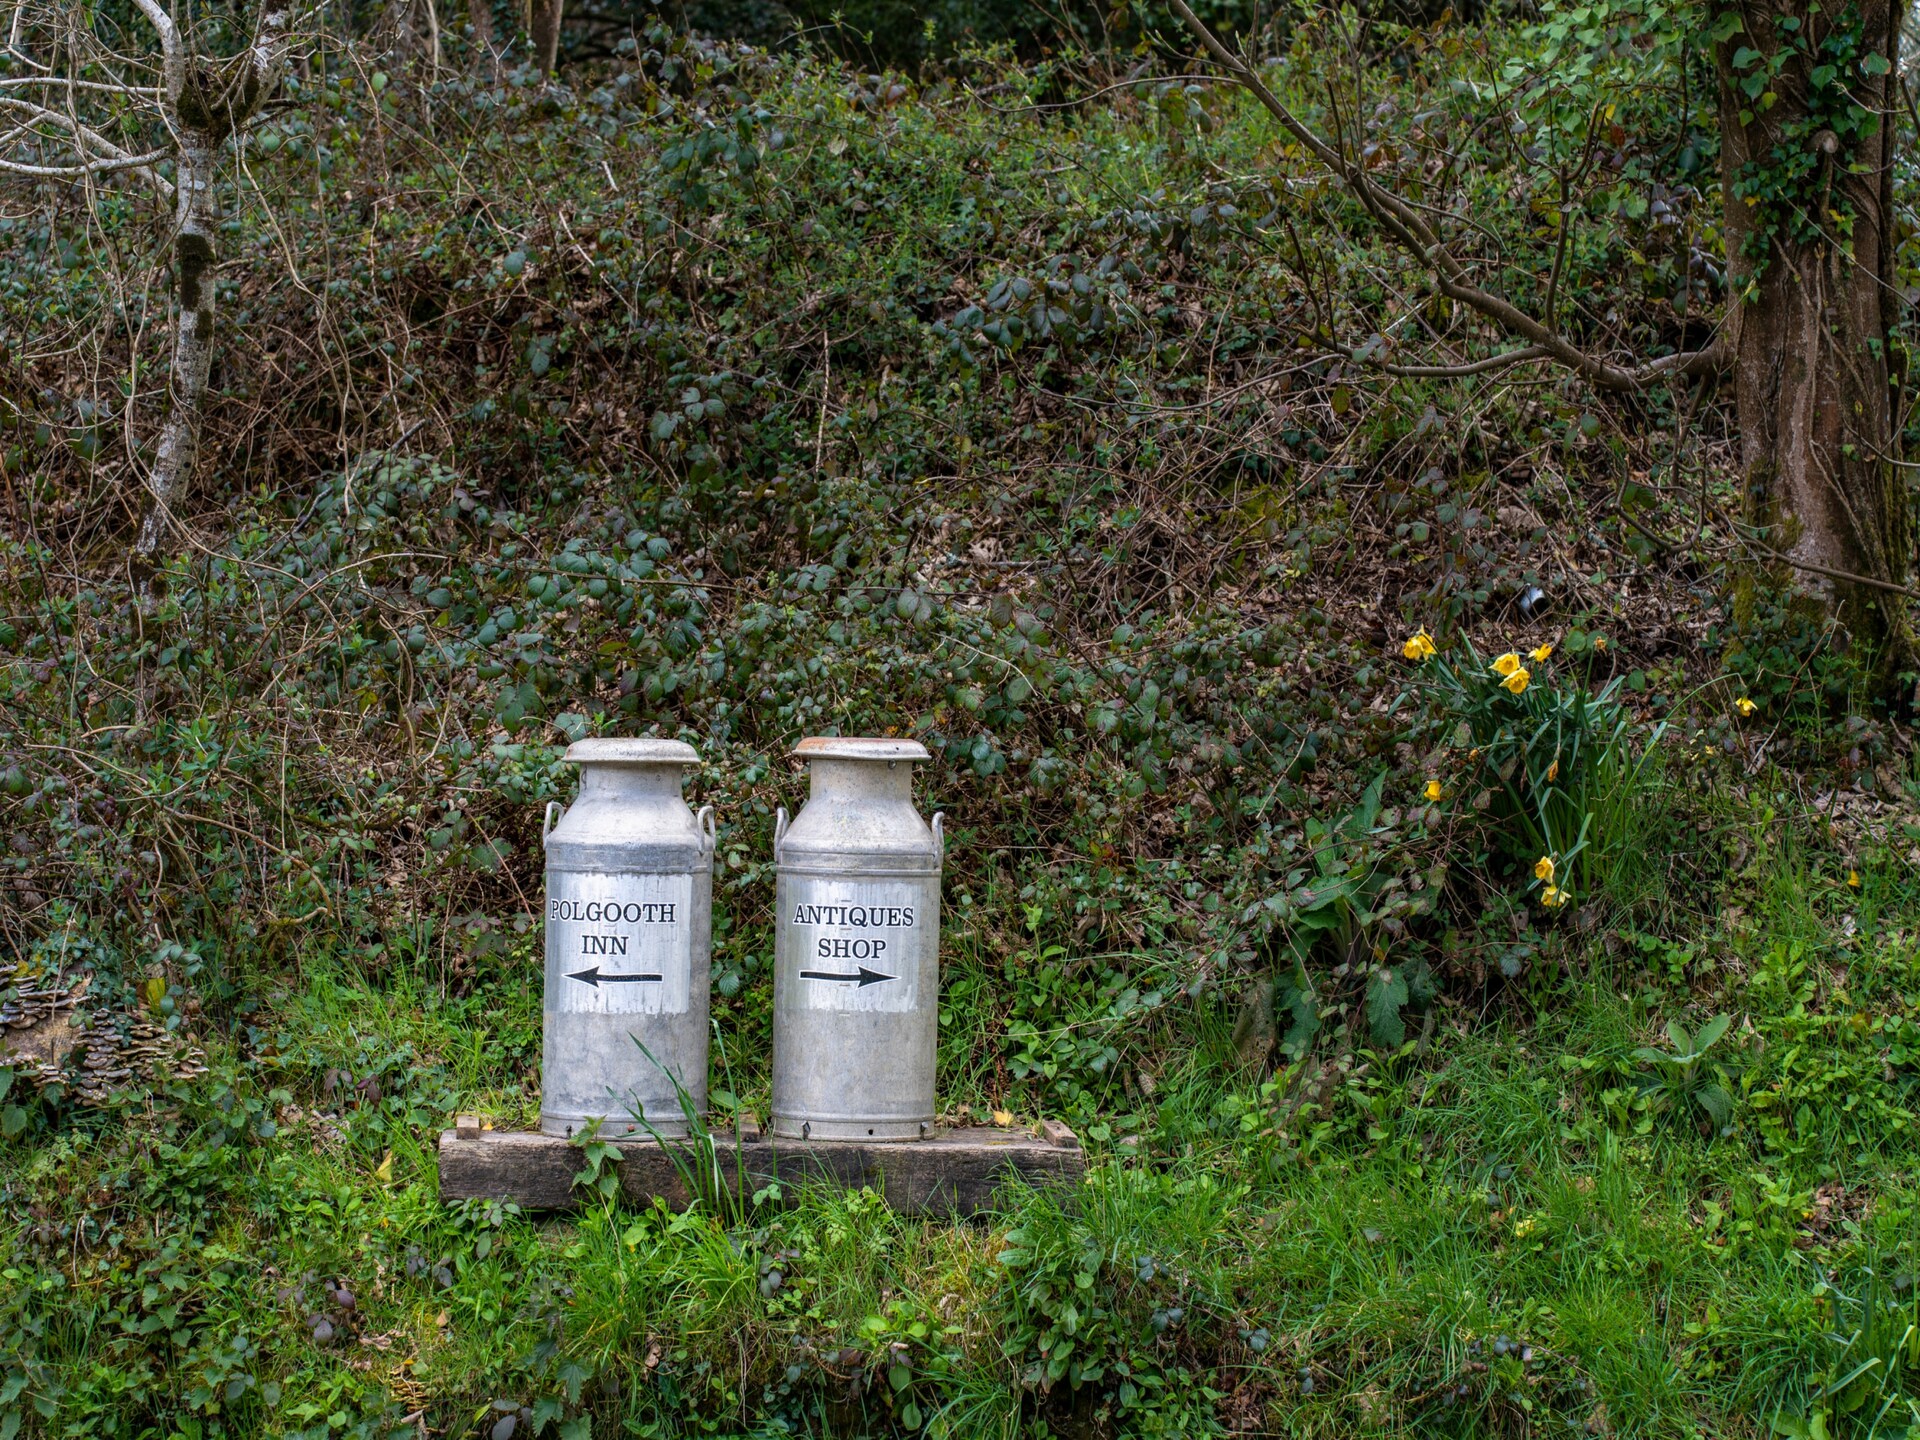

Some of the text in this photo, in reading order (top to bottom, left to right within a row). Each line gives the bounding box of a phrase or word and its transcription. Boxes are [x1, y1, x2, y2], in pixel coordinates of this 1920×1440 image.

[551, 900, 676, 923] POLGOOTH
[793, 905, 914, 927] ANTIQUES
[581, 935, 629, 955] INN
[818, 938, 886, 959] SHOP
